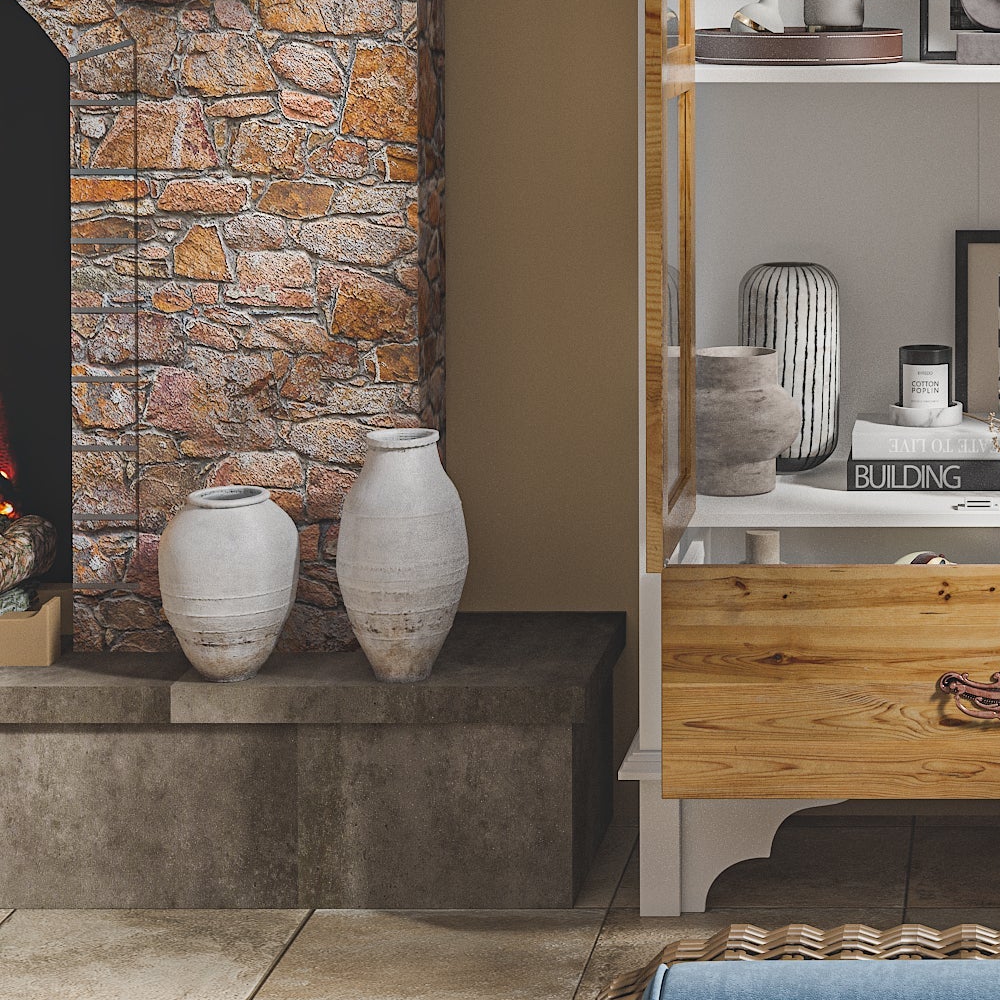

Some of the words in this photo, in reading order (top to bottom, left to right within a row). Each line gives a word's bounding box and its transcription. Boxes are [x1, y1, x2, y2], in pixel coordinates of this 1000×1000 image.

[888, 438, 926, 453] LIVE
[931, 438, 953, 453] TO
[855, 464, 962, 489] BUILDING
